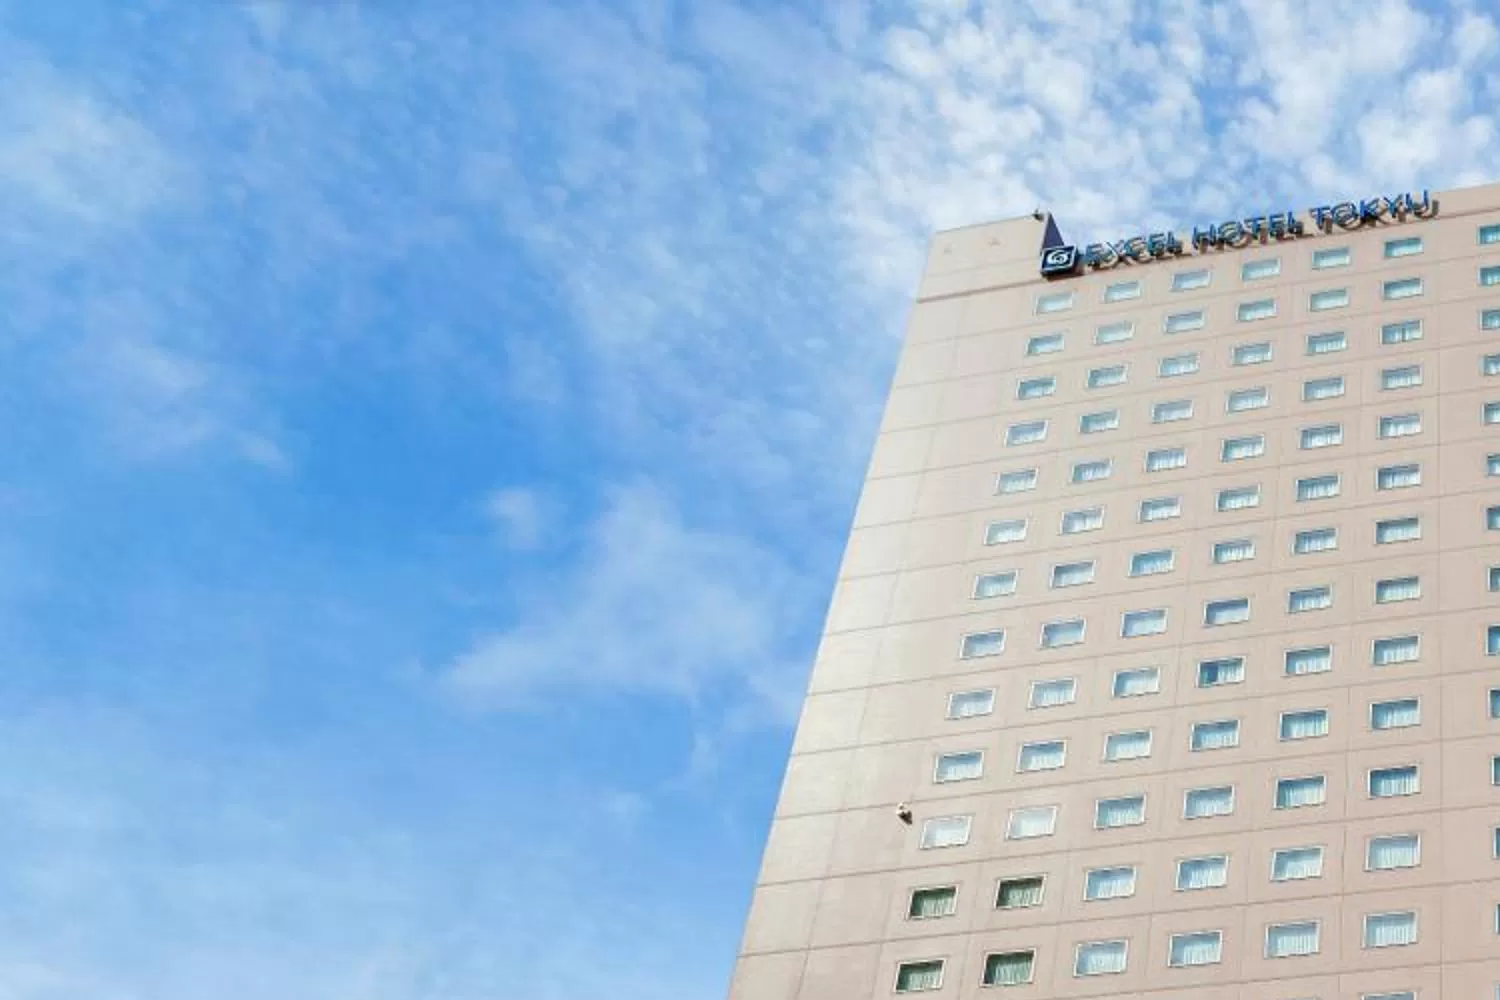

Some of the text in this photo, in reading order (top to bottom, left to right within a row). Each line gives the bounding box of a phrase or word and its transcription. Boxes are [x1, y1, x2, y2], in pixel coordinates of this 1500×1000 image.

[1084, 189, 1436, 267] EXCEL HOTEL TOKYU
